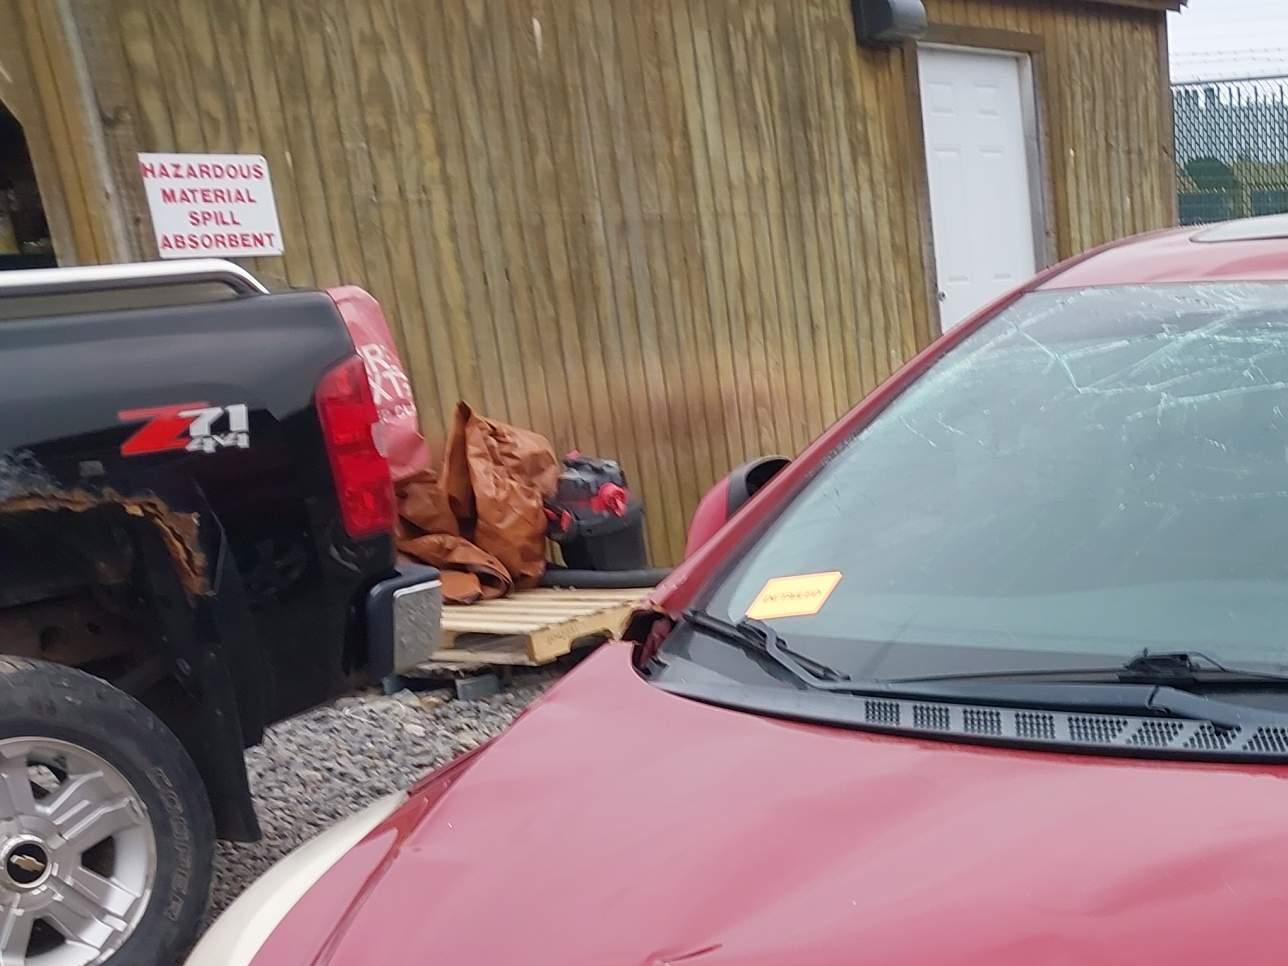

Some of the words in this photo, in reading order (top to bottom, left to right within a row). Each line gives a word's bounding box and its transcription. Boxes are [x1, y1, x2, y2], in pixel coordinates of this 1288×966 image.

[141, 163, 264, 179] HAZARDOUS
[161, 188, 257, 203] MATERIAL
[189, 211, 241, 226] SPILL
[160, 232, 275, 249] ABSORBENT
[117, 402, 249, 457] Z71
